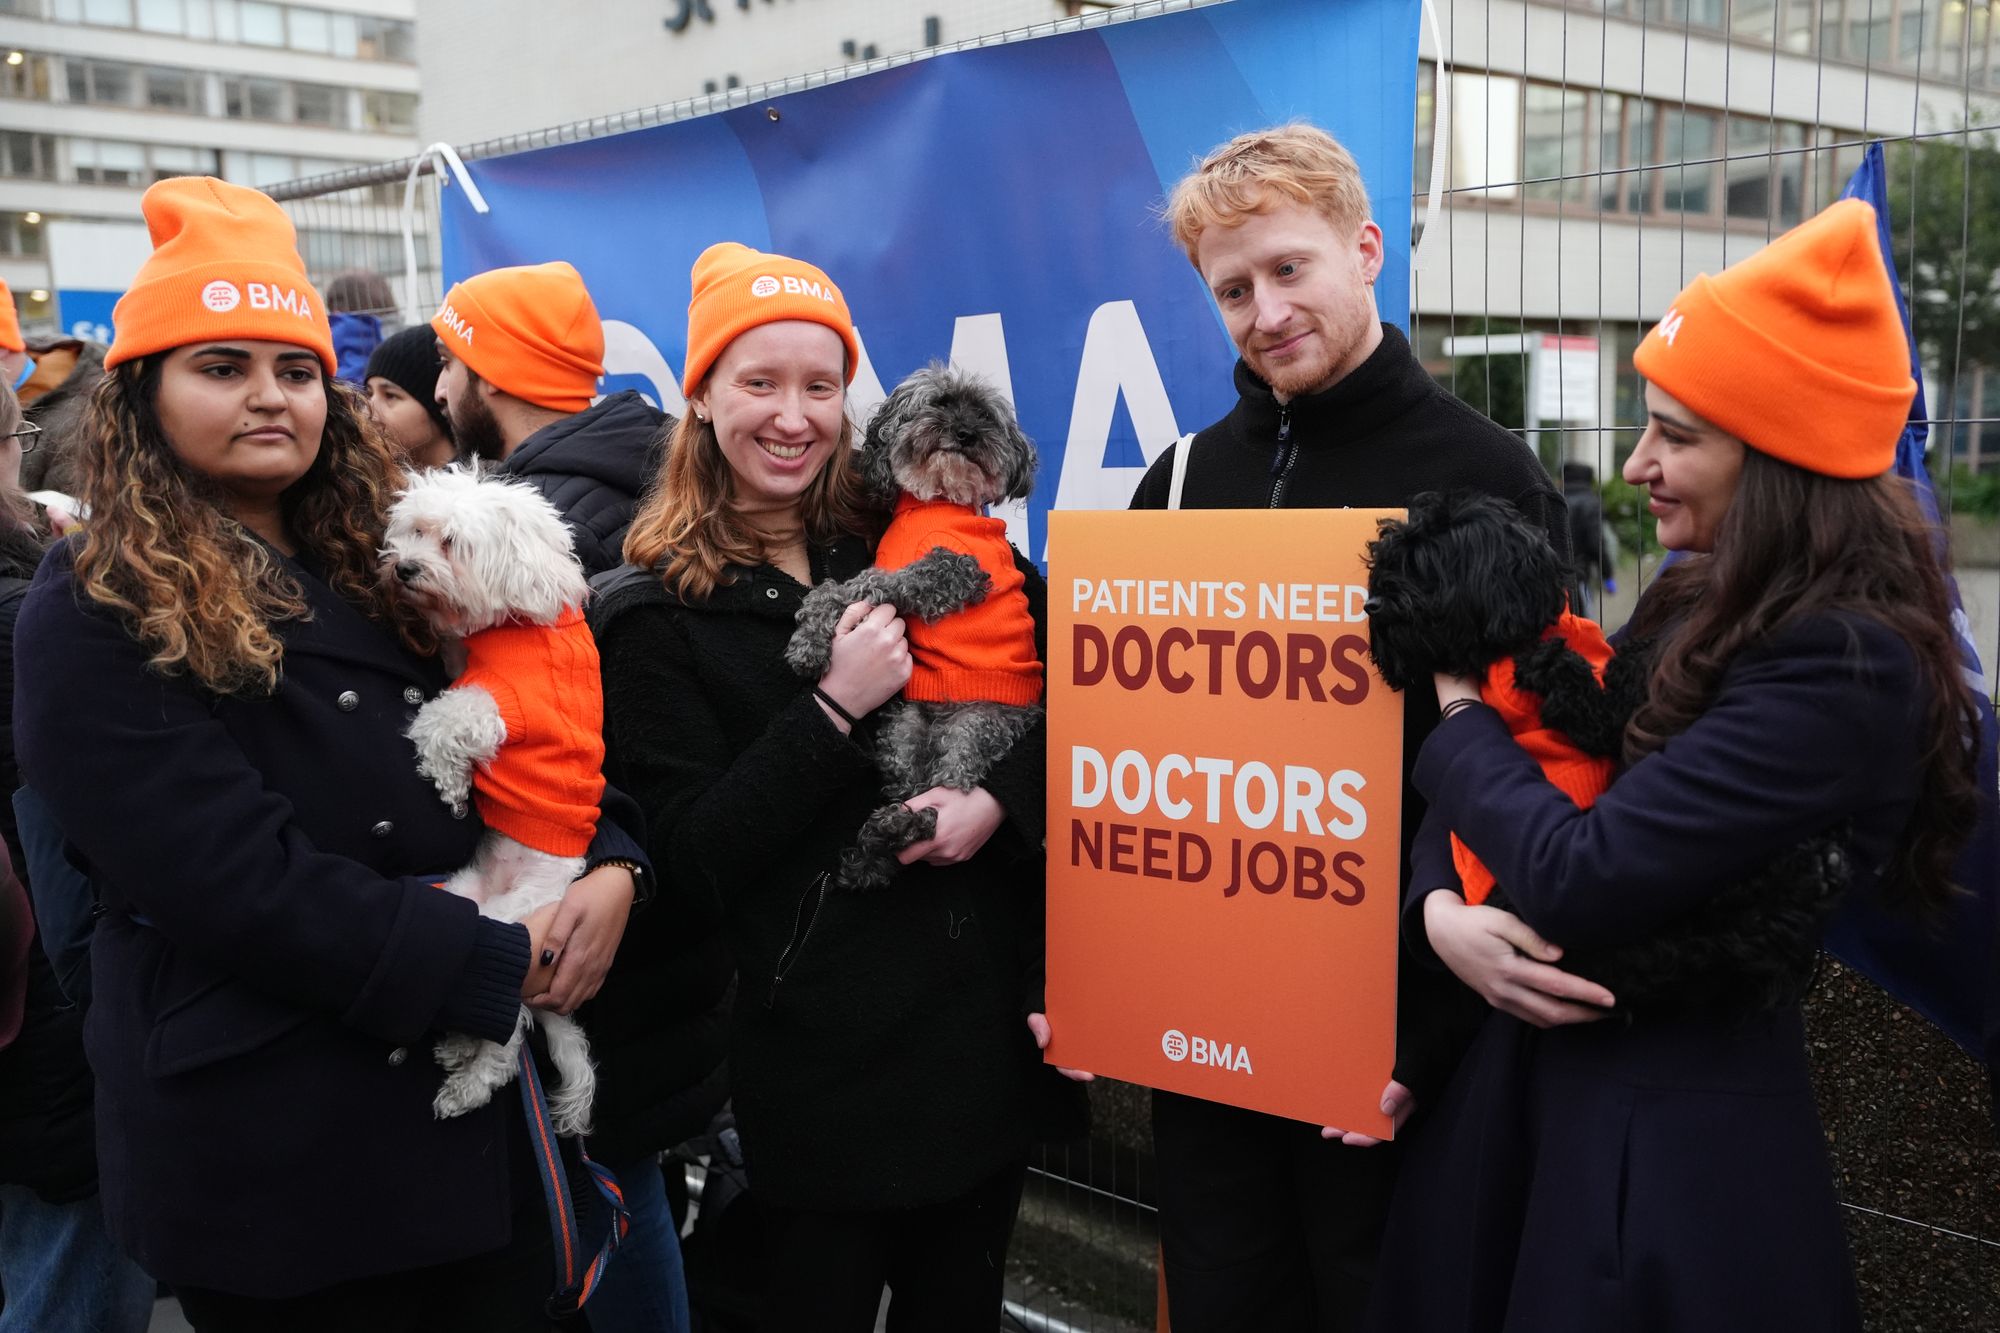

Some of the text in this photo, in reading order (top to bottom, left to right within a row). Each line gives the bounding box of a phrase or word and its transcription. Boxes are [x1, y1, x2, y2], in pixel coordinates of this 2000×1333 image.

[247, 282, 313, 320] BMA
[782, 276, 835, 304] BMA
[442, 305, 474, 346] BMA
[1073, 578, 1370, 623] PATIENTS NEED
[1072, 623, 1370, 706] DOCTORS
[1071, 745, 1368, 840] DOCTORS
[1071, 818, 1366, 907] NEED JOBS
[1191, 1036, 1253, 1075] BMA
